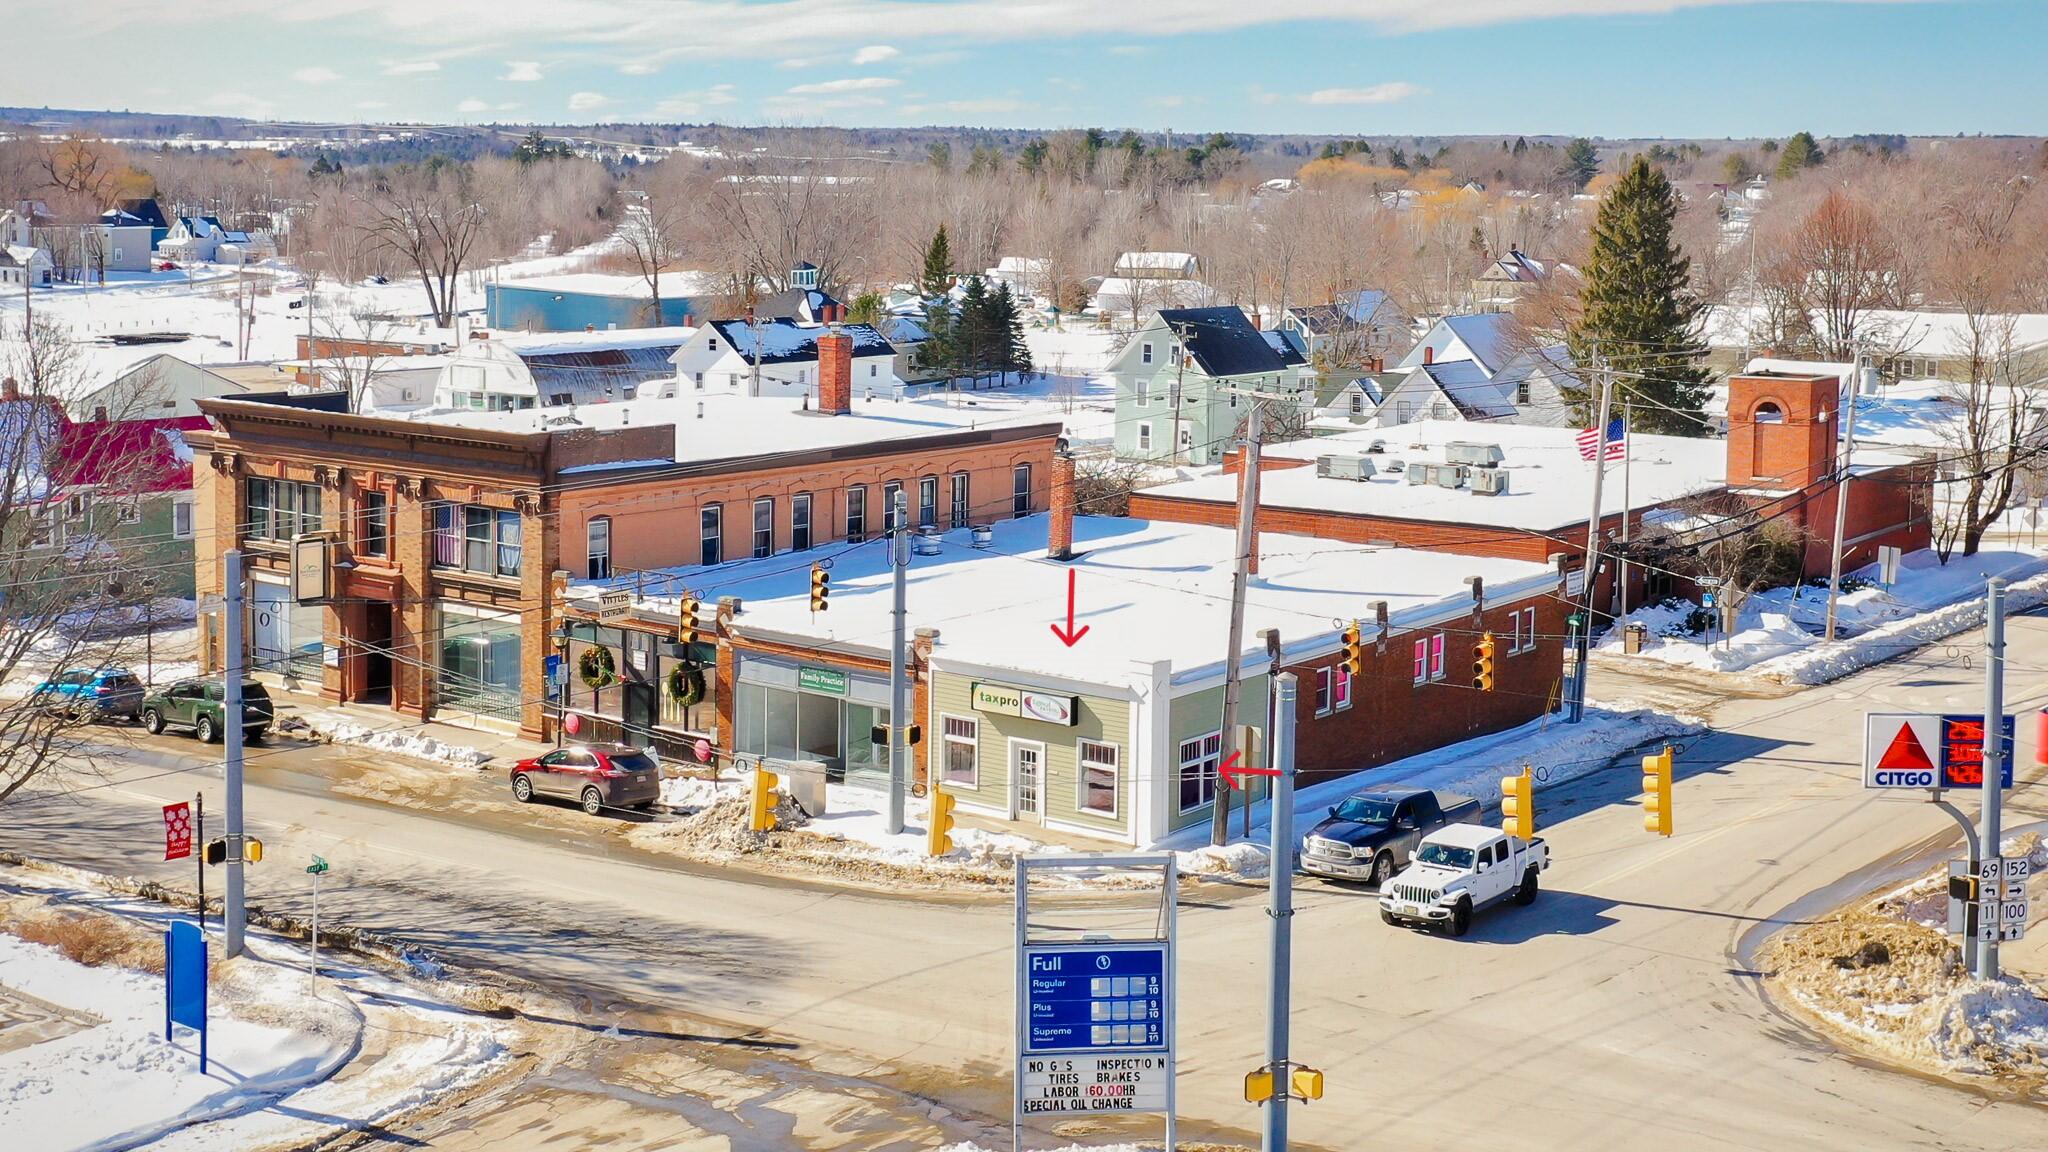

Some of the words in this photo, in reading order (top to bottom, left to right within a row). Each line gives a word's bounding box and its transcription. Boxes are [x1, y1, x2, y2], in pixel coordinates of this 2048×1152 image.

[601, 593, 629, 605] VITTLES
[800, 671, 820, 684] Family
[820, 675, 845, 687] Practice
[980, 691, 1019, 707] taxpro
[1875, 771, 1932, 786] CITGO
[1982, 863, 1998, 878] 69
[2006, 861, 2027, 876] 152
[1985, 905, 1994, 919] 11
[2005, 904, 2025, 919] 100
[1032, 956, 1061, 971] Full
[1033, 979, 1066, 988] Regular
[1150, 976, 1157, 984] 9
[1148, 986, 1159, 995] 10
[1033, 1003, 1051, 1011] Plus
[1150, 1000, 1157, 1009] 9
[1148, 1010, 1159, 1018] 10
[1033, 1027, 1072, 1036] Supreme
[1150, 1024, 1157, 1033] 9
[1148, 1034, 1159, 1043] 10
[1029, 1061, 1044, 1072] NO
[1049, 1073, 1079, 1084] TIRES
[1097, 1071, 1141, 1083] BRAKES
[1044, 1086, 1079, 1098] LABOR
[1024, 1099, 1066, 1113] SPECIAL
[1071, 1099, 1087, 1110] OIL
[1092, 1097, 1133, 1109] CHANGE
